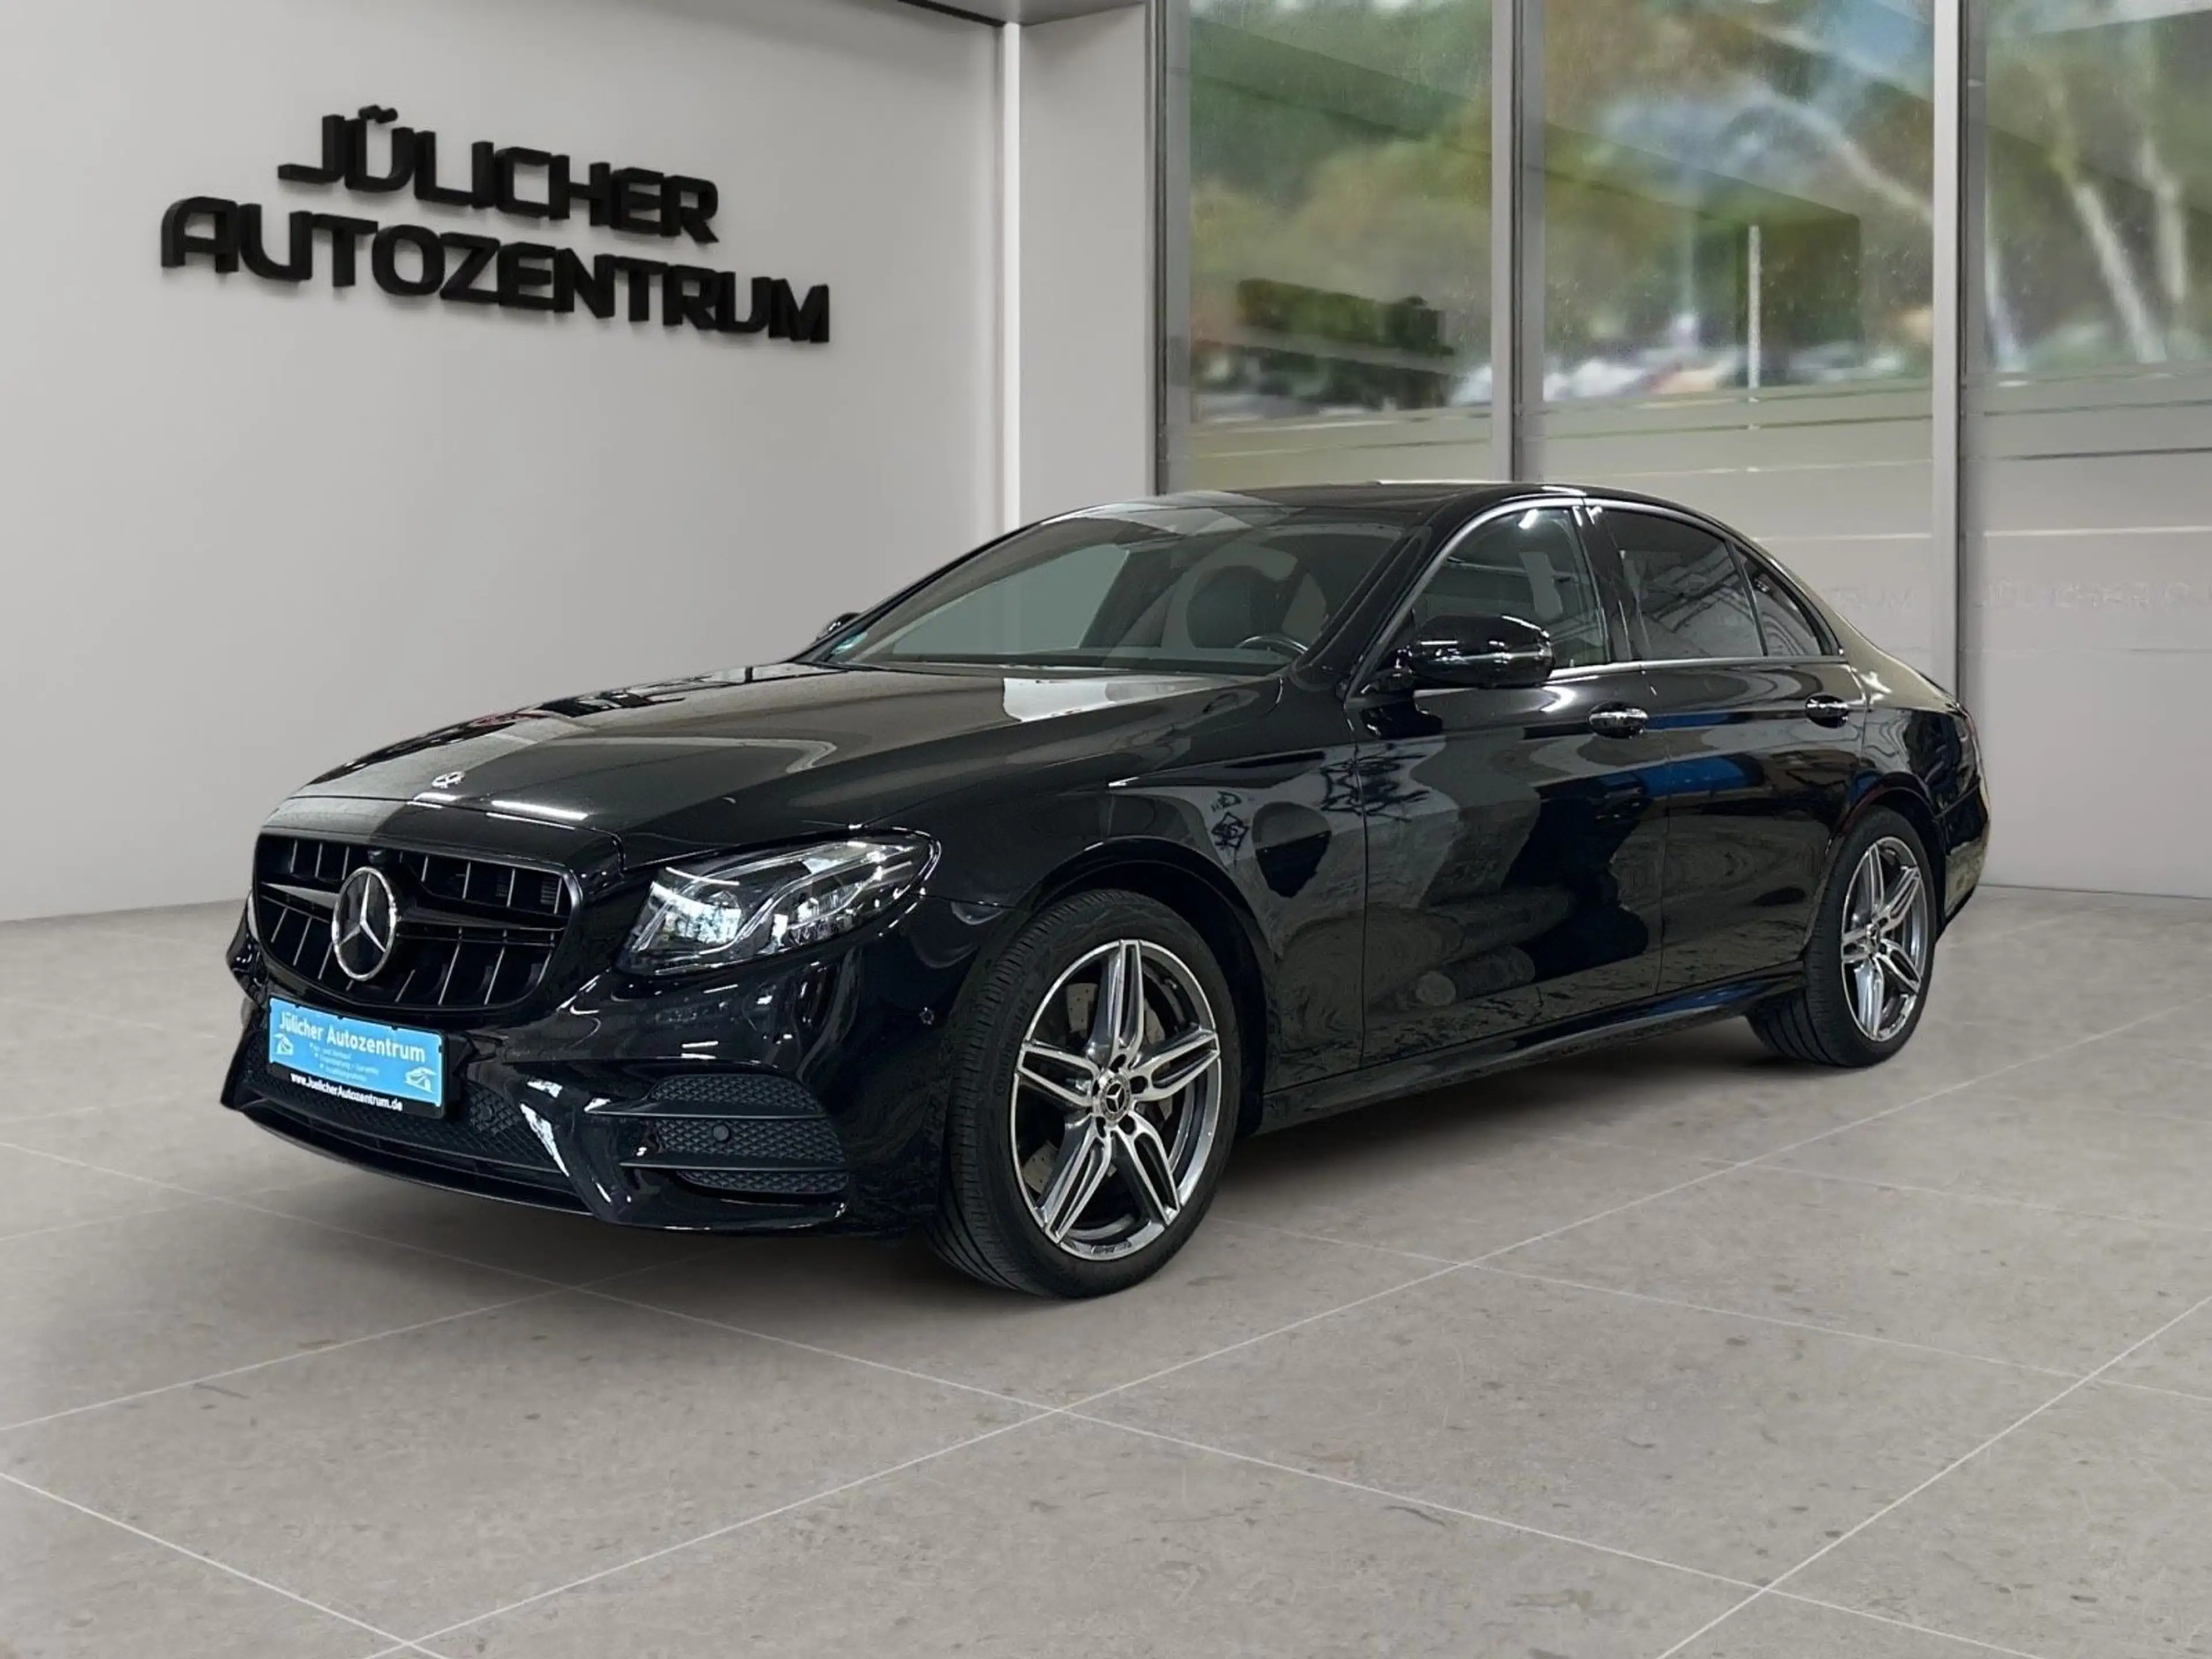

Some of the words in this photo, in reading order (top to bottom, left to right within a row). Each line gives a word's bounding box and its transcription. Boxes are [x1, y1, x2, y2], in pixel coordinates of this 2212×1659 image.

[278, 105, 718, 243] JÜLICHER
[161, 196, 829, 343] AUTOZENTRUM
[279, 1012, 324, 1040] Jülicher
[326, 1024, 425, 1063] Autozentrum
